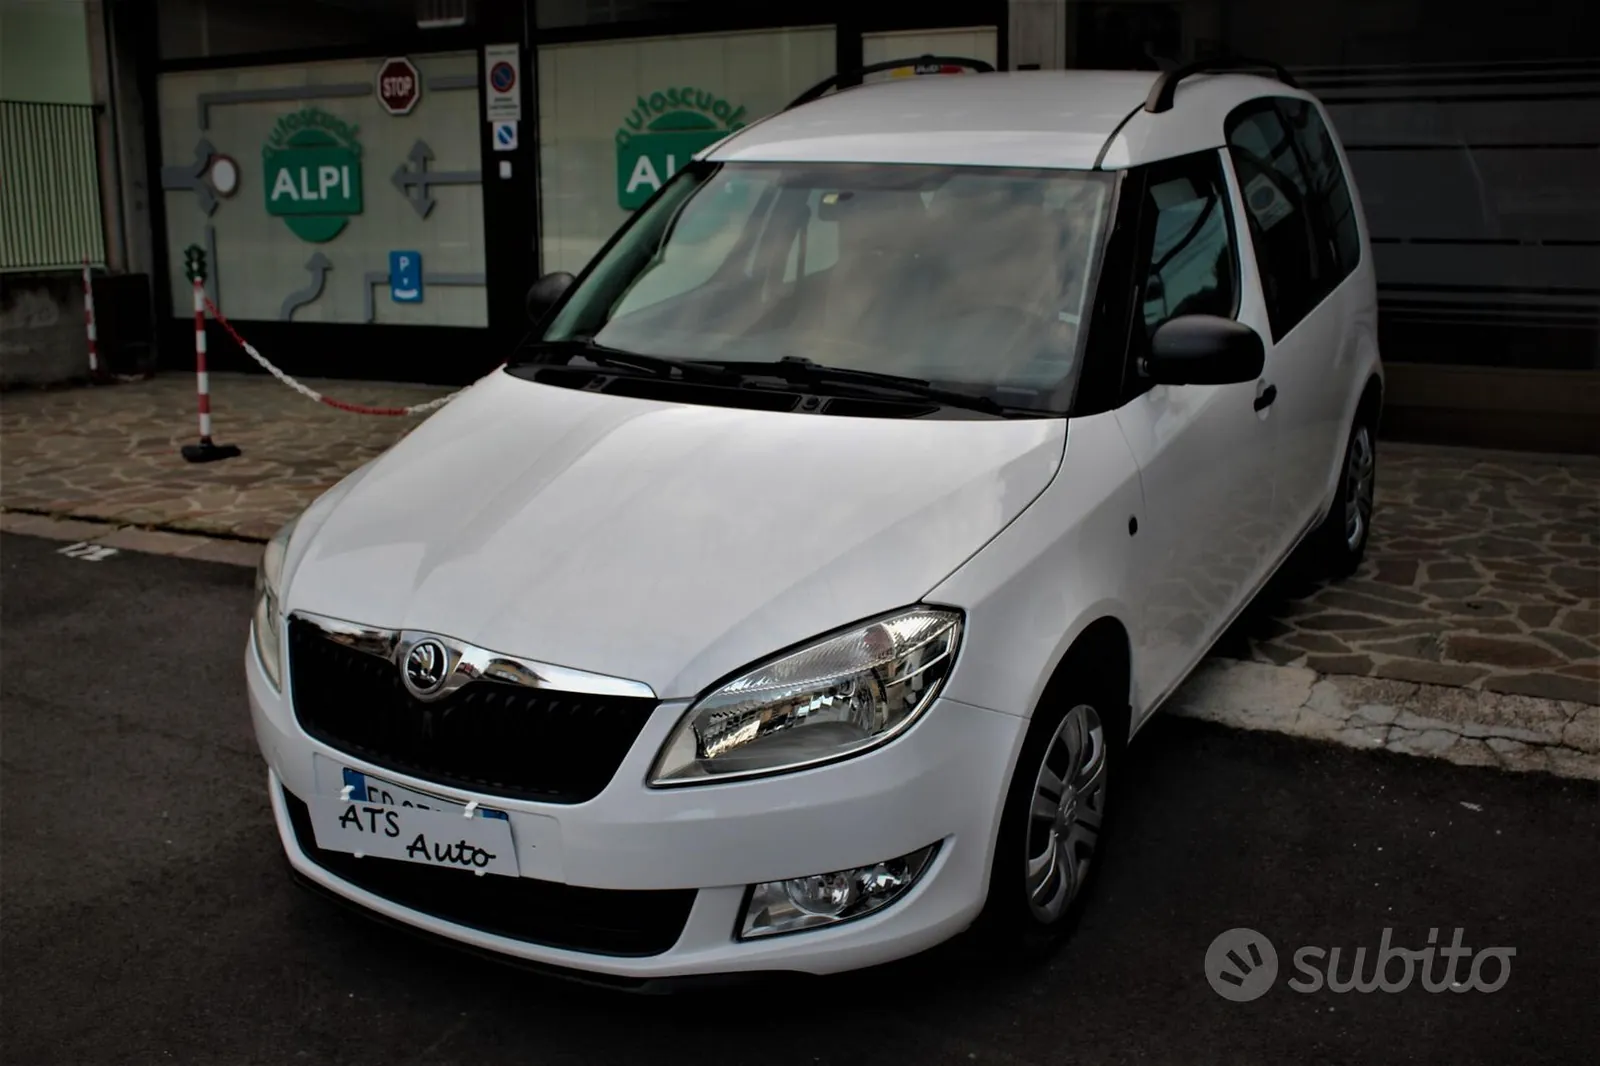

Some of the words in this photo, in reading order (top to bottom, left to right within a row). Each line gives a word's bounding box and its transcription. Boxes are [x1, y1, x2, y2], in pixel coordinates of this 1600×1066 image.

[383, 76, 413, 98] STOP
[270, 164, 351, 202] ALPI
[399, 256, 410, 272] P
[338, 804, 400, 837] ATS
[405, 834, 496, 867] Auto
